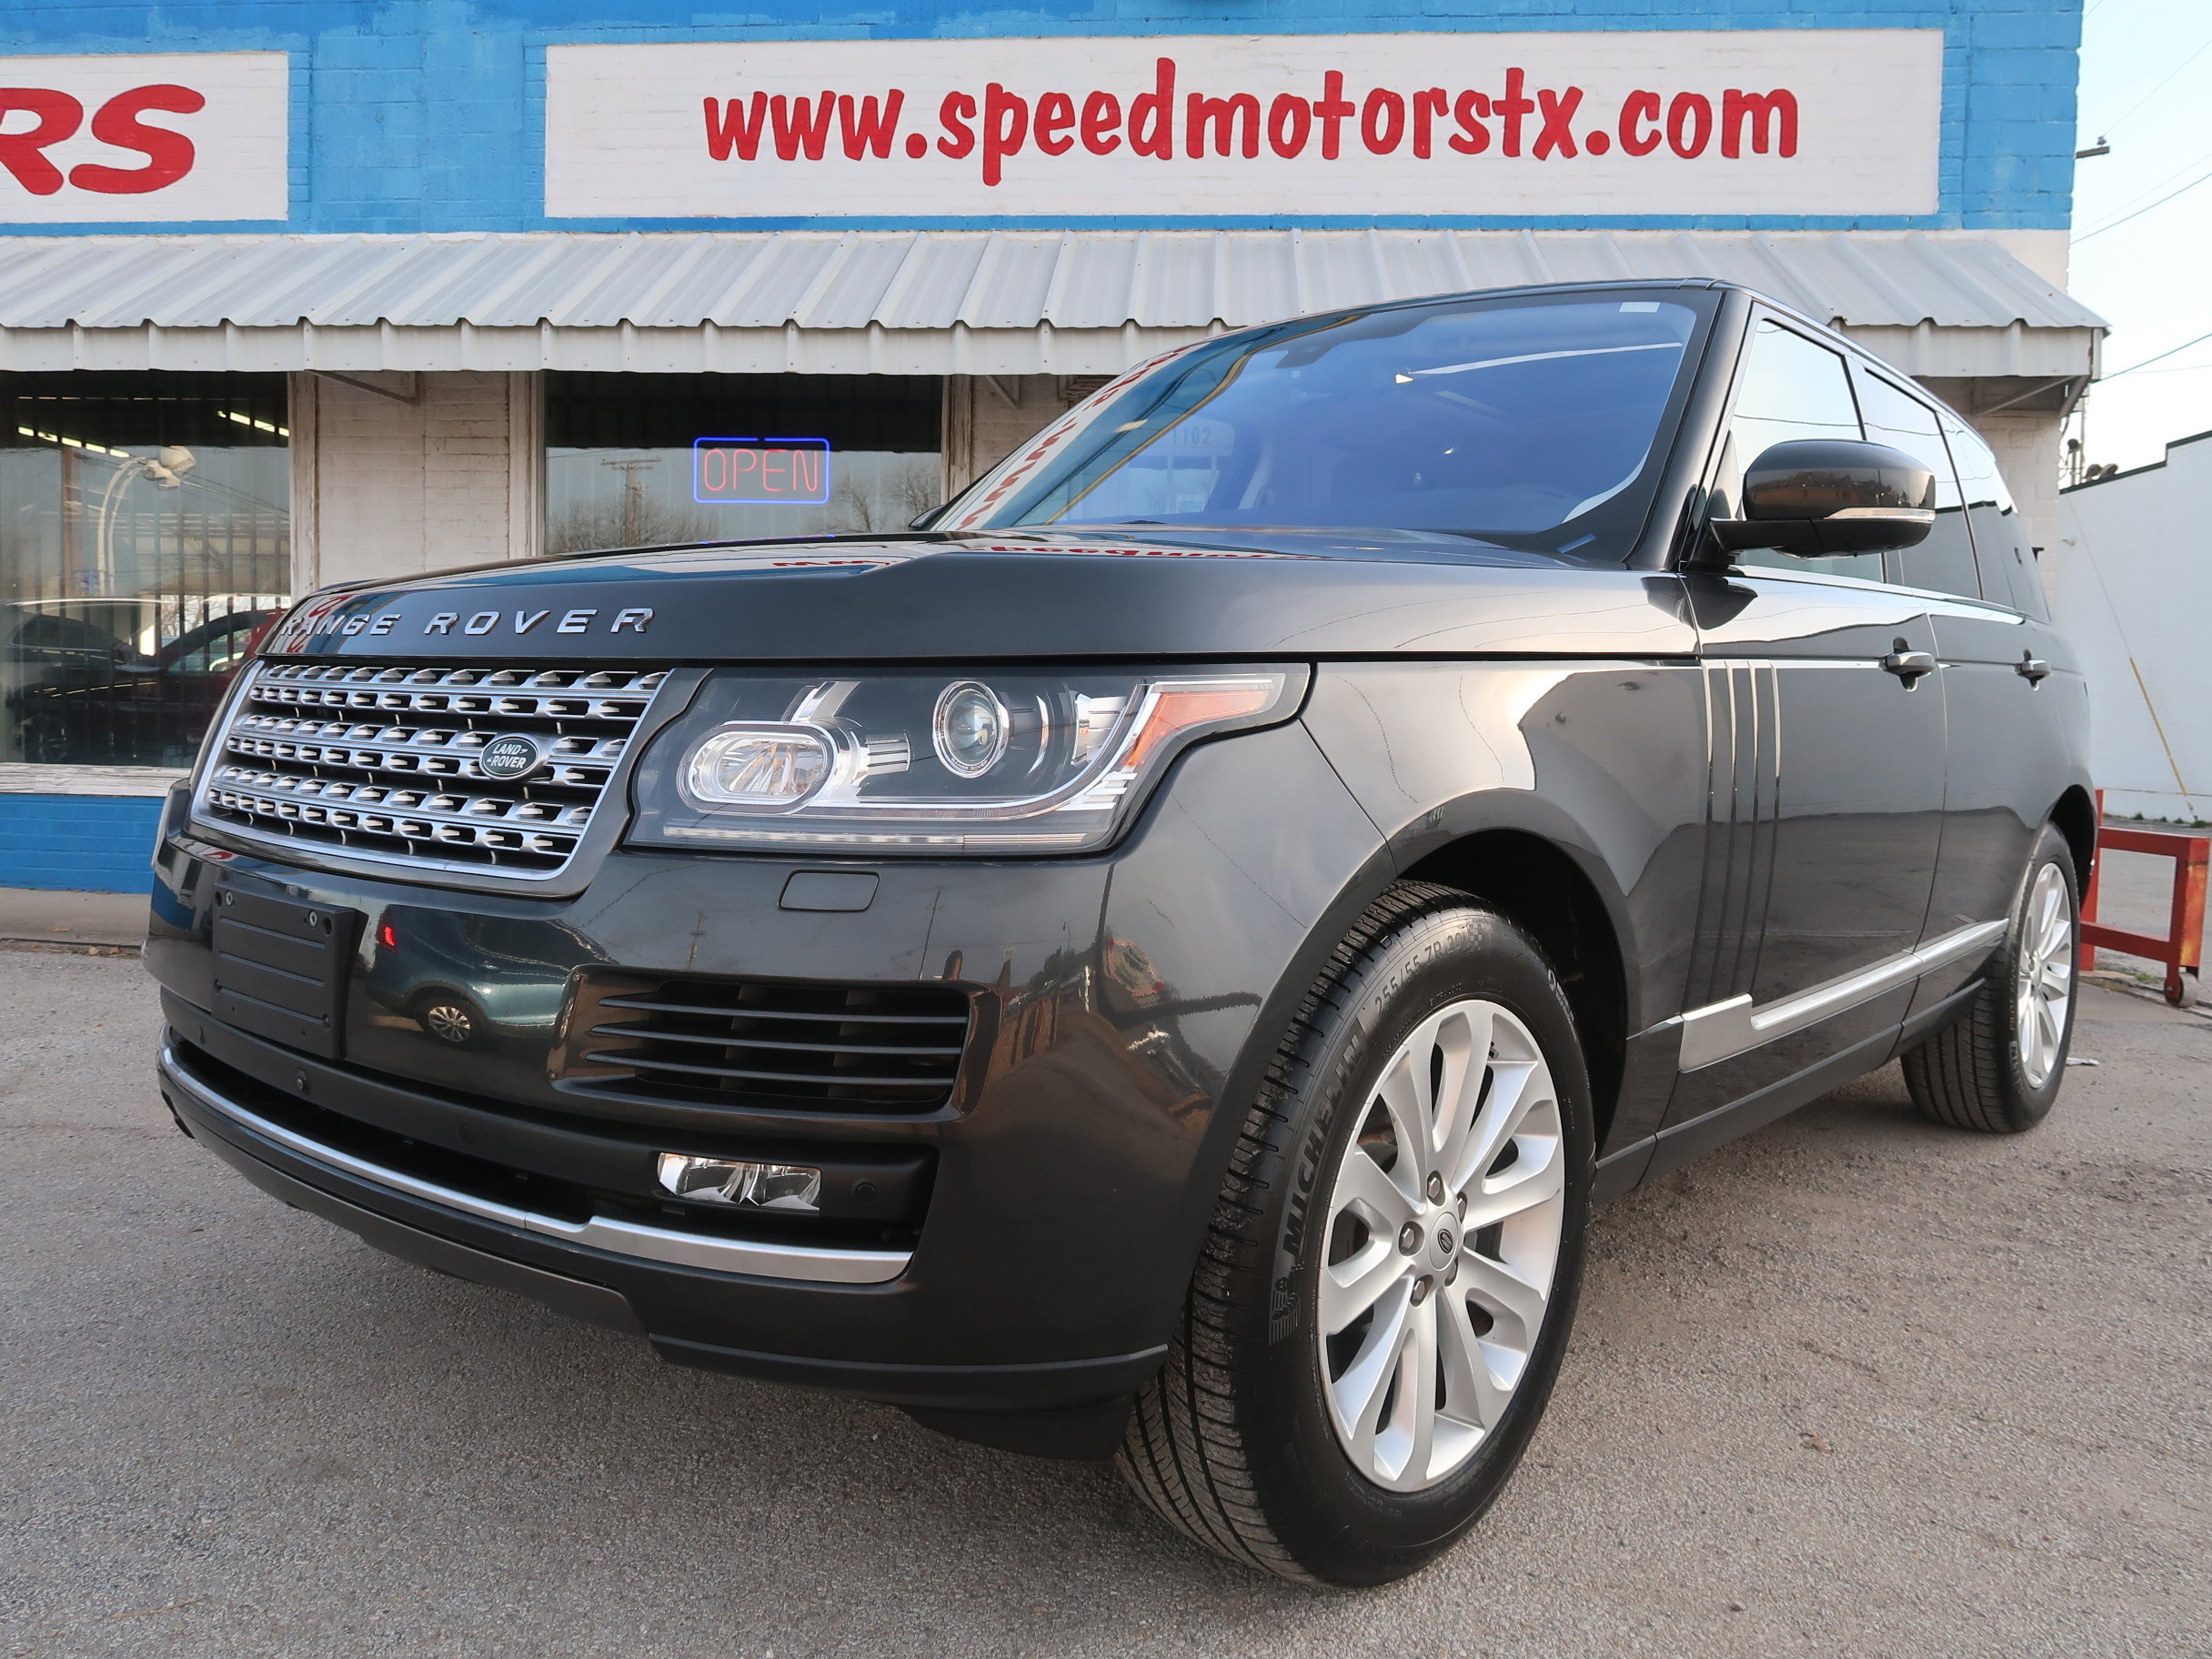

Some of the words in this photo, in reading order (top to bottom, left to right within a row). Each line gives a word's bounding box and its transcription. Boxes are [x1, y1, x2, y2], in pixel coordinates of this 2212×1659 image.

[704, 58, 1797, 186] www.speedmotorstx.com
[703, 448, 818, 492] OPEN
[280, 612, 403, 636] RANGE
[424, 608, 655, 636] ROVER
[490, 755, 527, 769] ROVER
[492, 743, 522, 756] LAND
[1374, 955, 1421, 1014] 255/55
[1282, 1034, 1362, 1258] MICHELIN
